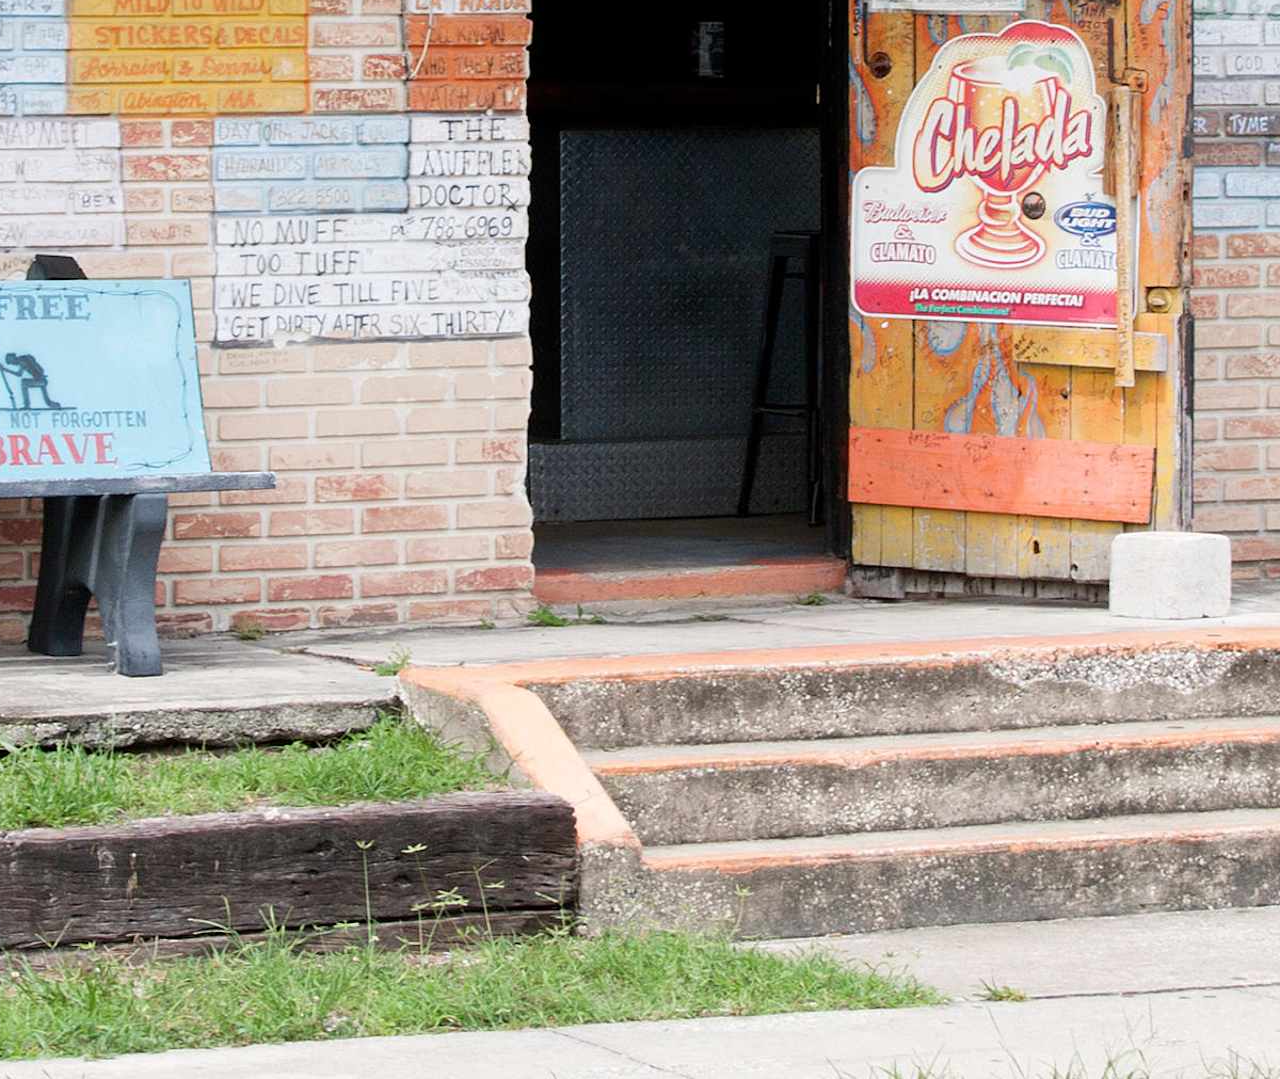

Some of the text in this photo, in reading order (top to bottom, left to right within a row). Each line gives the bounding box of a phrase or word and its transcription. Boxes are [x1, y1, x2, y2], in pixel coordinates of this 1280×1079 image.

[95, 24, 306, 46] STICKERS DECALS
[440, 119, 506, 143] THE
[913, 87, 1093, 193] Chelada
[1062, 217, 1117, 229] LIGHT
[1069, 207, 1111, 218] BUD
[231, 221, 265, 247] NO
[274, 218, 348, 246] MUFF
[240, 250, 361, 275] TOO TUFF
[871, 243, 936, 265] CLAMATO
[273, 283, 321, 306] DIVE
[333, 282, 380, 303] TILL
[931, 289, 1022, 304] COMBINACION
[10, 411, 46, 430] NOT
[51, 409, 148, 430] FORGOTTEN
